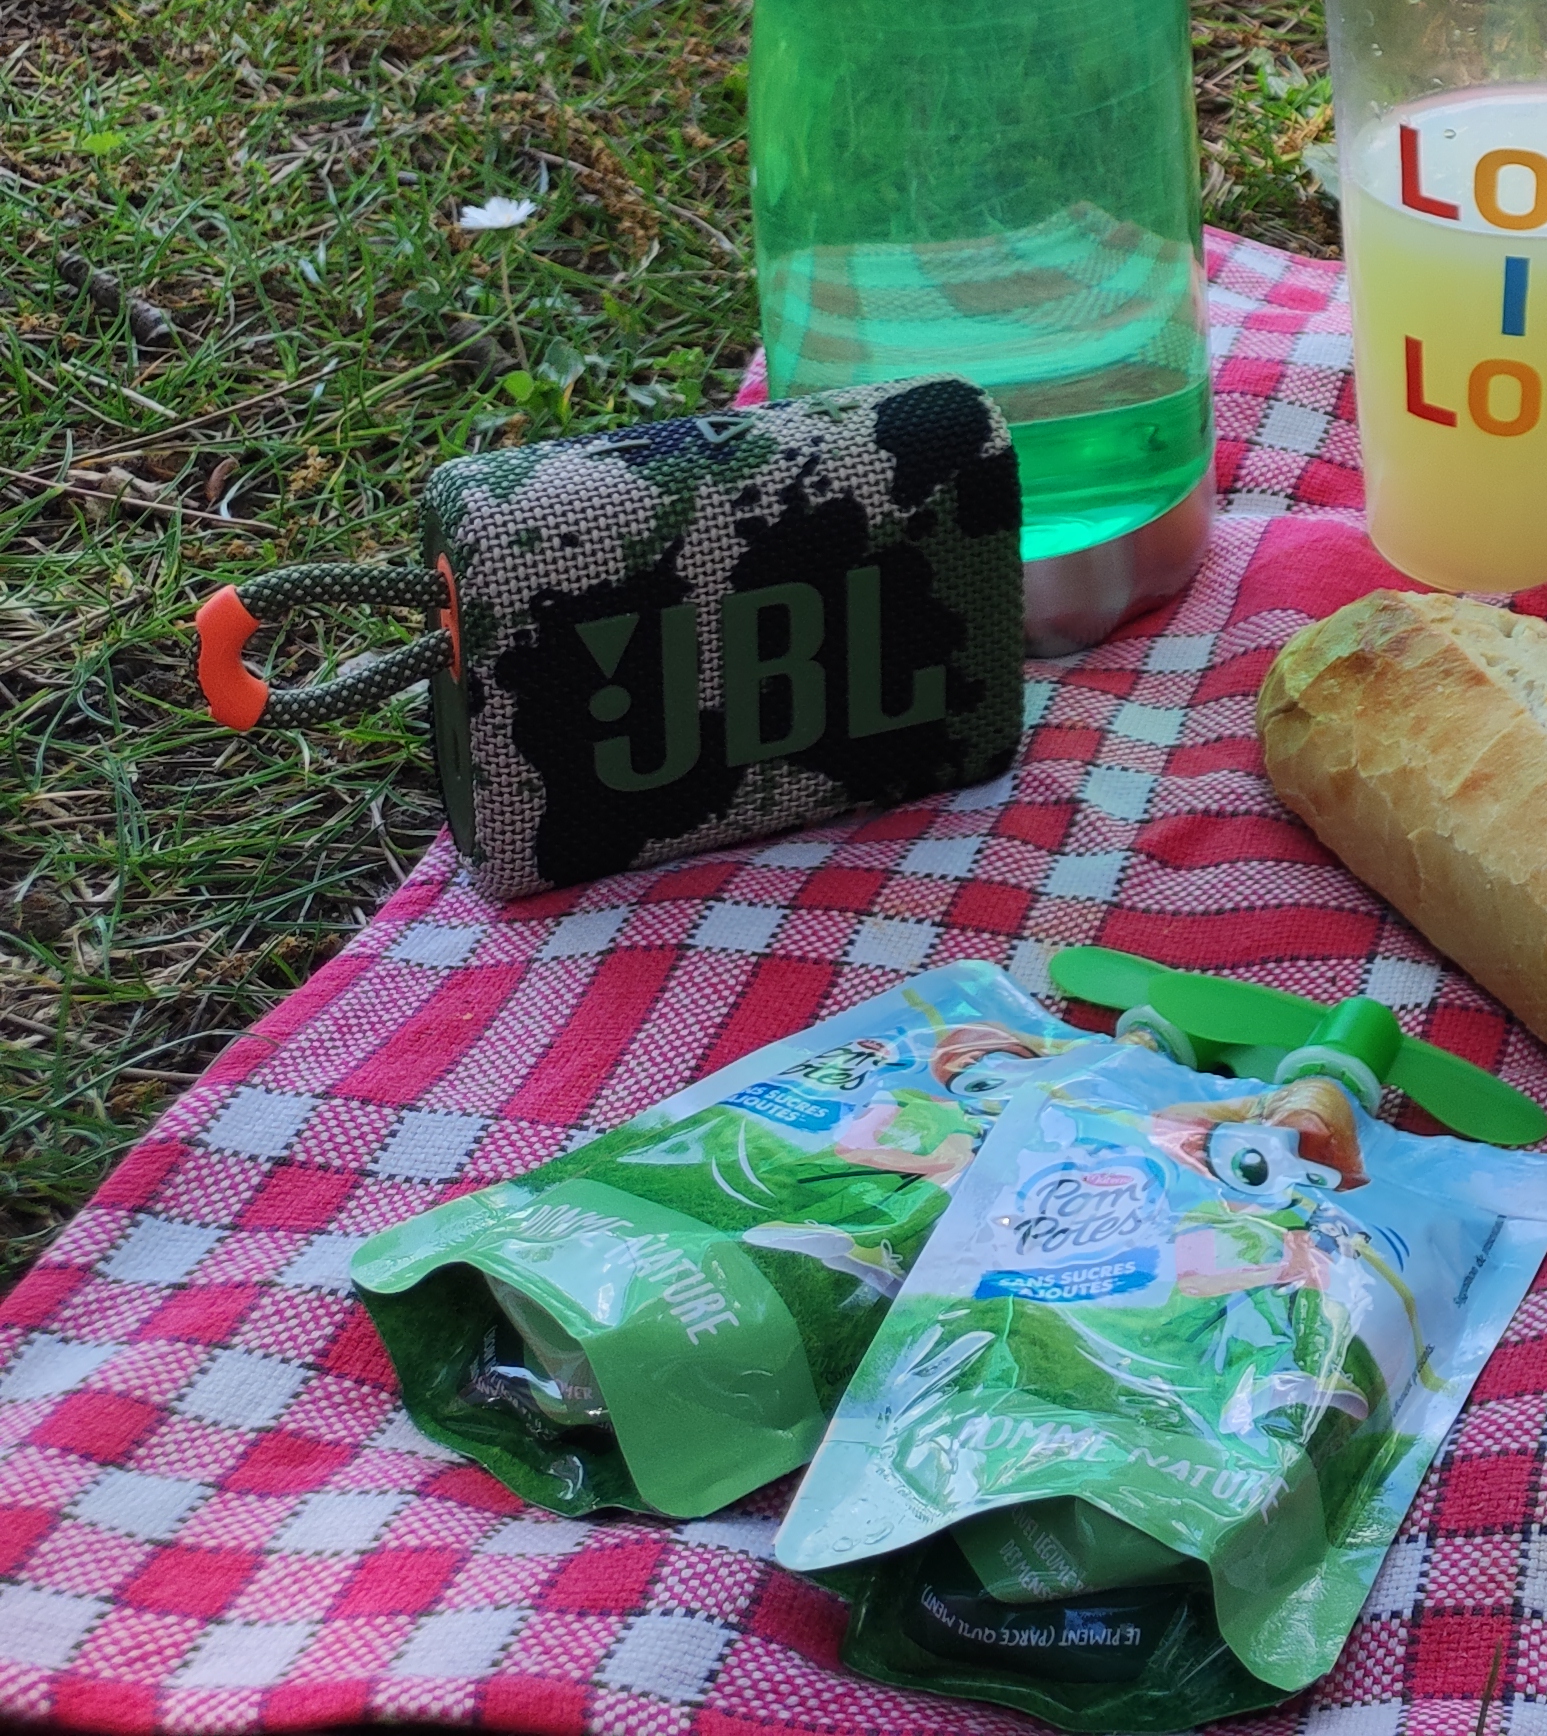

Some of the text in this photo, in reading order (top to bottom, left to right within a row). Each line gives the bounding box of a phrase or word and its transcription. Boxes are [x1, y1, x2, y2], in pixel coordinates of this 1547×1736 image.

[594, 565, 946, 792] JBL
[765, 1089, 829, 1118] SUCRES
[1013, 1207, 1142, 1255] Potes
[998, 1262, 1136, 1287] SANS SUCRES
[604, 1234, 740, 1345] NATURE
[957, 1414, 1290, 1525] POMME NATURE
[1000, 1625, 1056, 1647] (PARCE
[1058, 1627, 1122, 1647] PIMENT
[1126, 1627, 1141, 1646] LE
